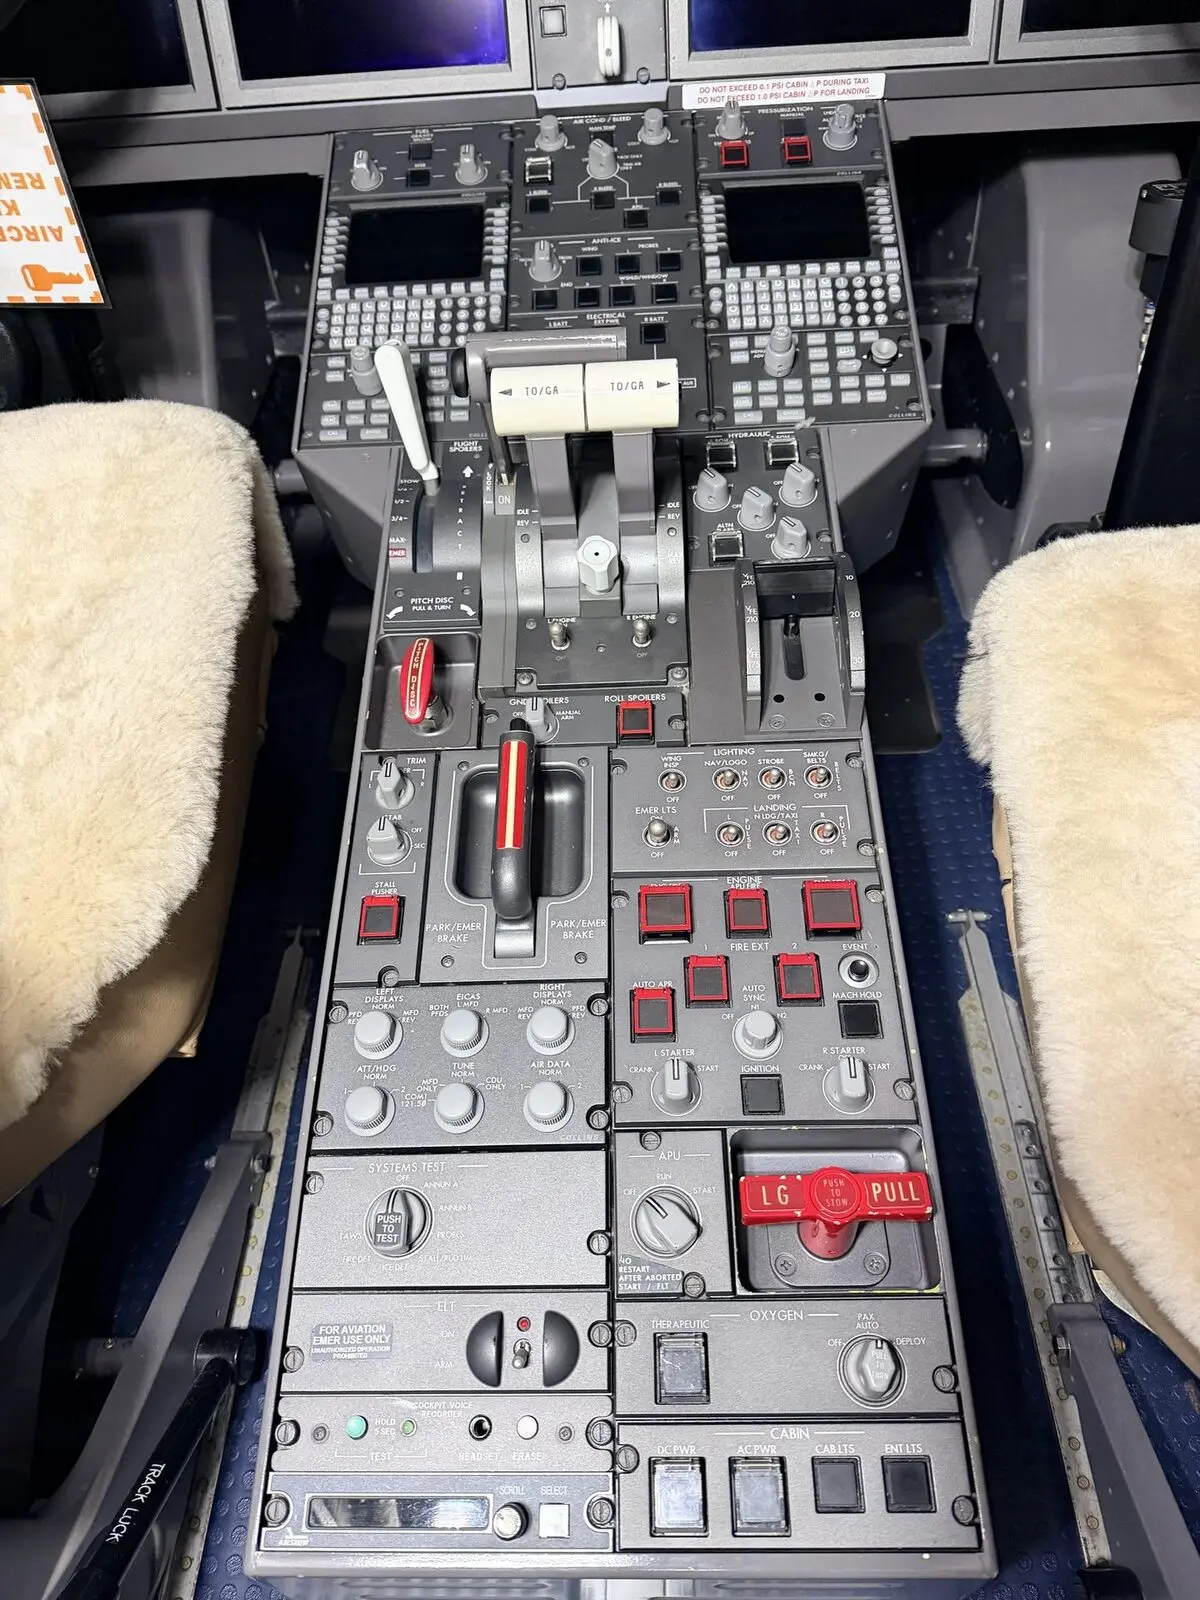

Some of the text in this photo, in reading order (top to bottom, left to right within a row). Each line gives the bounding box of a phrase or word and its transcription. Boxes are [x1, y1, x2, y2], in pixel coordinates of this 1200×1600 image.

[729, 84, 758, 92] EXCEED
[785, 80, 808, 88] CABIN
[783, 90, 806, 98] CABIN
[837, 87, 870, 95] LANDING
[586, 312, 626, 320] ELECTRICAL
[525, 386, 560, 396] TO/GA
[610, 382, 644, 392] TO/GA
[728, 430, 770, 439] HYDRAULIC
[498, 496, 511, 504] ON
[628, 694, 666, 702] SPOILERS
[714, 748, 756, 757] LIGHTING
[704, 759, 748, 767] NAV/LOGO
[635, 806, 659, 814] EMER
[754, 803, 797, 812] LANDING
[726, 876, 763, 884] ENGINE
[425, 922, 482, 933] PARK/EMER
[550, 918, 607, 928] PARK/EMER
[437, 934, 469, 942] BRAKE
[562, 930, 594, 939] BRAKE
[730, 942, 770, 951] FIRE EXT
[742, 984, 766, 992] AUTO
[456, 992, 480, 1000] EICAS
[533, 990, 572, 998] DISPLAYS
[832, 990, 882, 1000] MACH HOLD
[365, 995, 404, 1004] DISPLAYS
[660, 1048, 696, 1057] STARTER
[830, 1046, 866, 1054] STARTER
[356, 1064, 396, 1073] ATT/HDG
[452, 1062, 475, 1070] TUNE
[530, 1060, 570, 1068] AIR DATA
[740, 1064, 780, 1072] IGNITION
[798, 1064, 824, 1072] CRANK
[868, 1062, 890, 1070] START
[452, 1070, 475, 1078] NORM
[538, 1068, 562, 1076] NORM
[629, 1066, 654, 1074] CRANK
[486, 1082, 506, 1090] ONLY
[658, 1152, 681, 1162] APU
[368, 1162, 446, 1174] SYSTEMS TEST
[656, 1172, 672, 1180] RUN
[693, 1186, 716, 1194] START
[871, 1182, 920, 1202] PULL
[377, 1214, 401, 1224] PUSH
[382, 1224, 395, 1234] TO
[376, 1233, 400, 1243] TEST
[618, 1265, 650, 1274] RESTART
[618, 1273, 682, 1282] AFTER ABORTED
[618, 1282, 642, 1290] START
[656, 1282, 670, 1290] FLT
[438, 1302, 456, 1312] ELT
[750, 1310, 804, 1320] OXYGEN
[857, 1312, 875, 1320] PAX
[319, 1324, 386, 1334] FOR AVIATION
[651, 1320, 710, 1330] THERAPEUTIC
[856, 1322, 880, 1330] AUTO
[312, 1334, 392, 1346] EMER USE ONLY
[896, 1337, 926, 1346] DEPLOY
[412, 1400, 474, 1410] COCKPIT VOICE
[421, 1409, 463, 1418] RECORDER
[374, 1418, 396, 1426] HOLD
[770, 1427, 810, 1440] CABIN
[657, 1445, 696, 1455] DC PWR
[737, 1444, 777, 1454] AC PWR
[815, 1444, 855, 1454] CAB LTS
[884, 1444, 922, 1454] ENT LTS
[370, 1452, 392, 1462] TEST
[458, 1452, 500, 1462] HEADSET
[512, 1452, 542, 1461] ERASE
[499, 1486, 525, 1496] SCROLL
[541, 1486, 568, 1496] SELECT
[105, 1462, 166, 1542] TRACK LUCK
